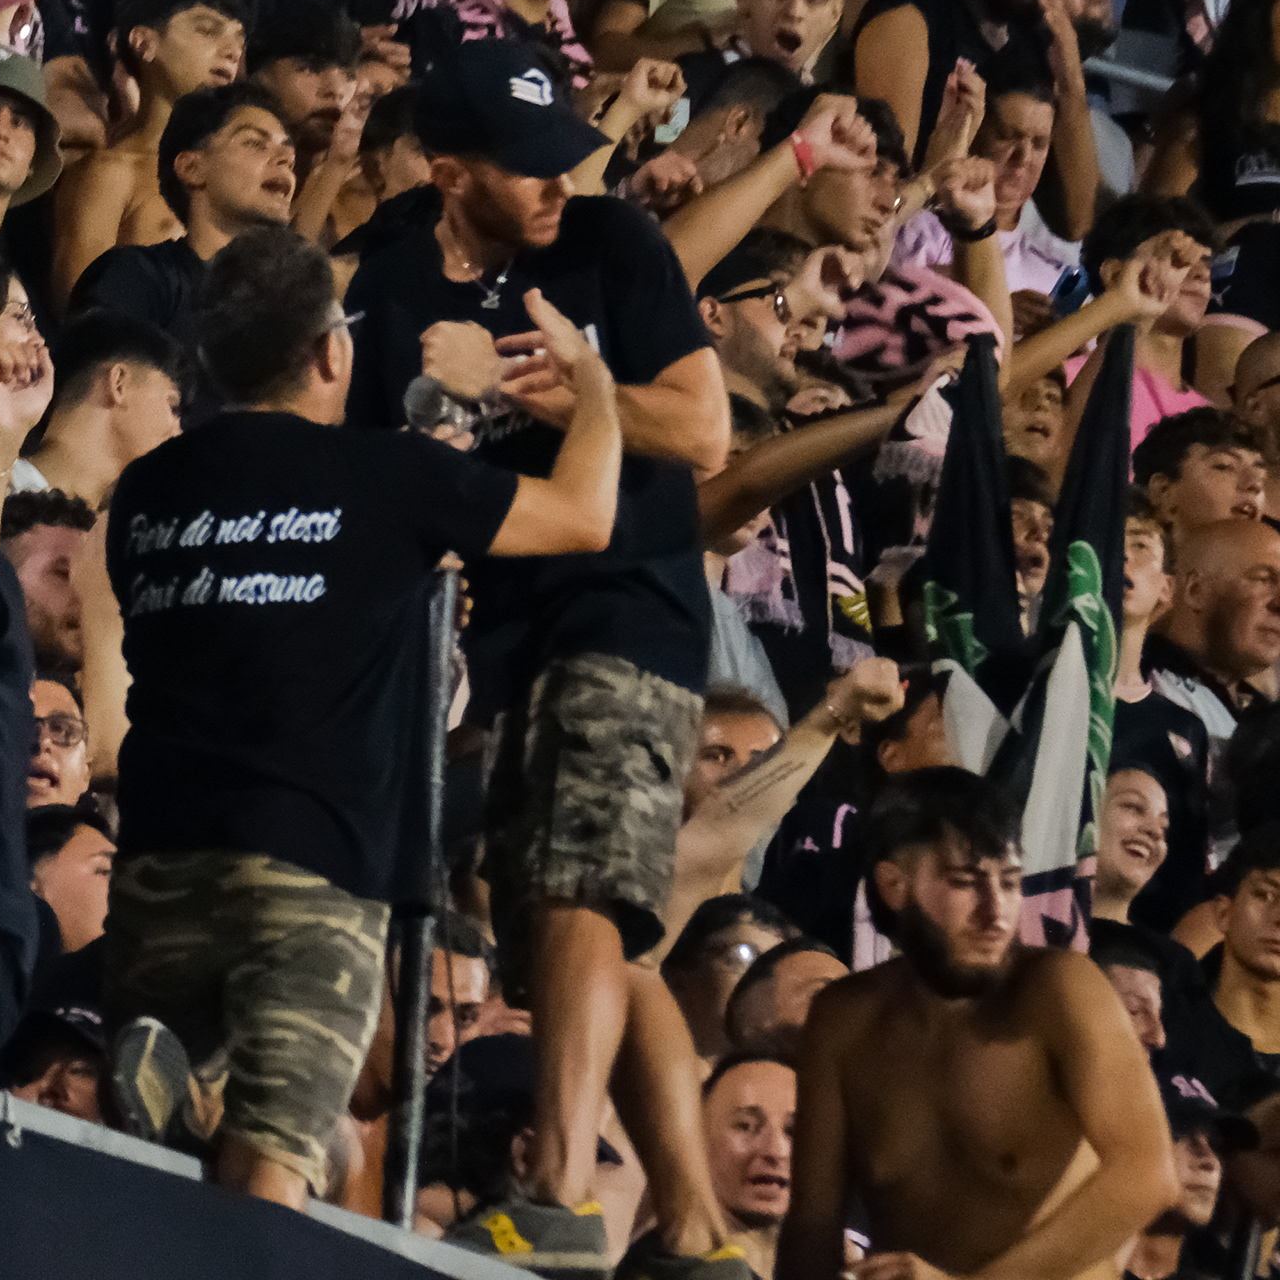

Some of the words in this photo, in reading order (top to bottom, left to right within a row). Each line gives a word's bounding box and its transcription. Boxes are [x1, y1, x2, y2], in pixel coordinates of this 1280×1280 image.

[179, 509, 216, 548] di
[214, 509, 264, 545] noi
[266, 506, 342, 544] stessi
[182, 566, 215, 606] di
[217, 572, 327, 606] nessuno
